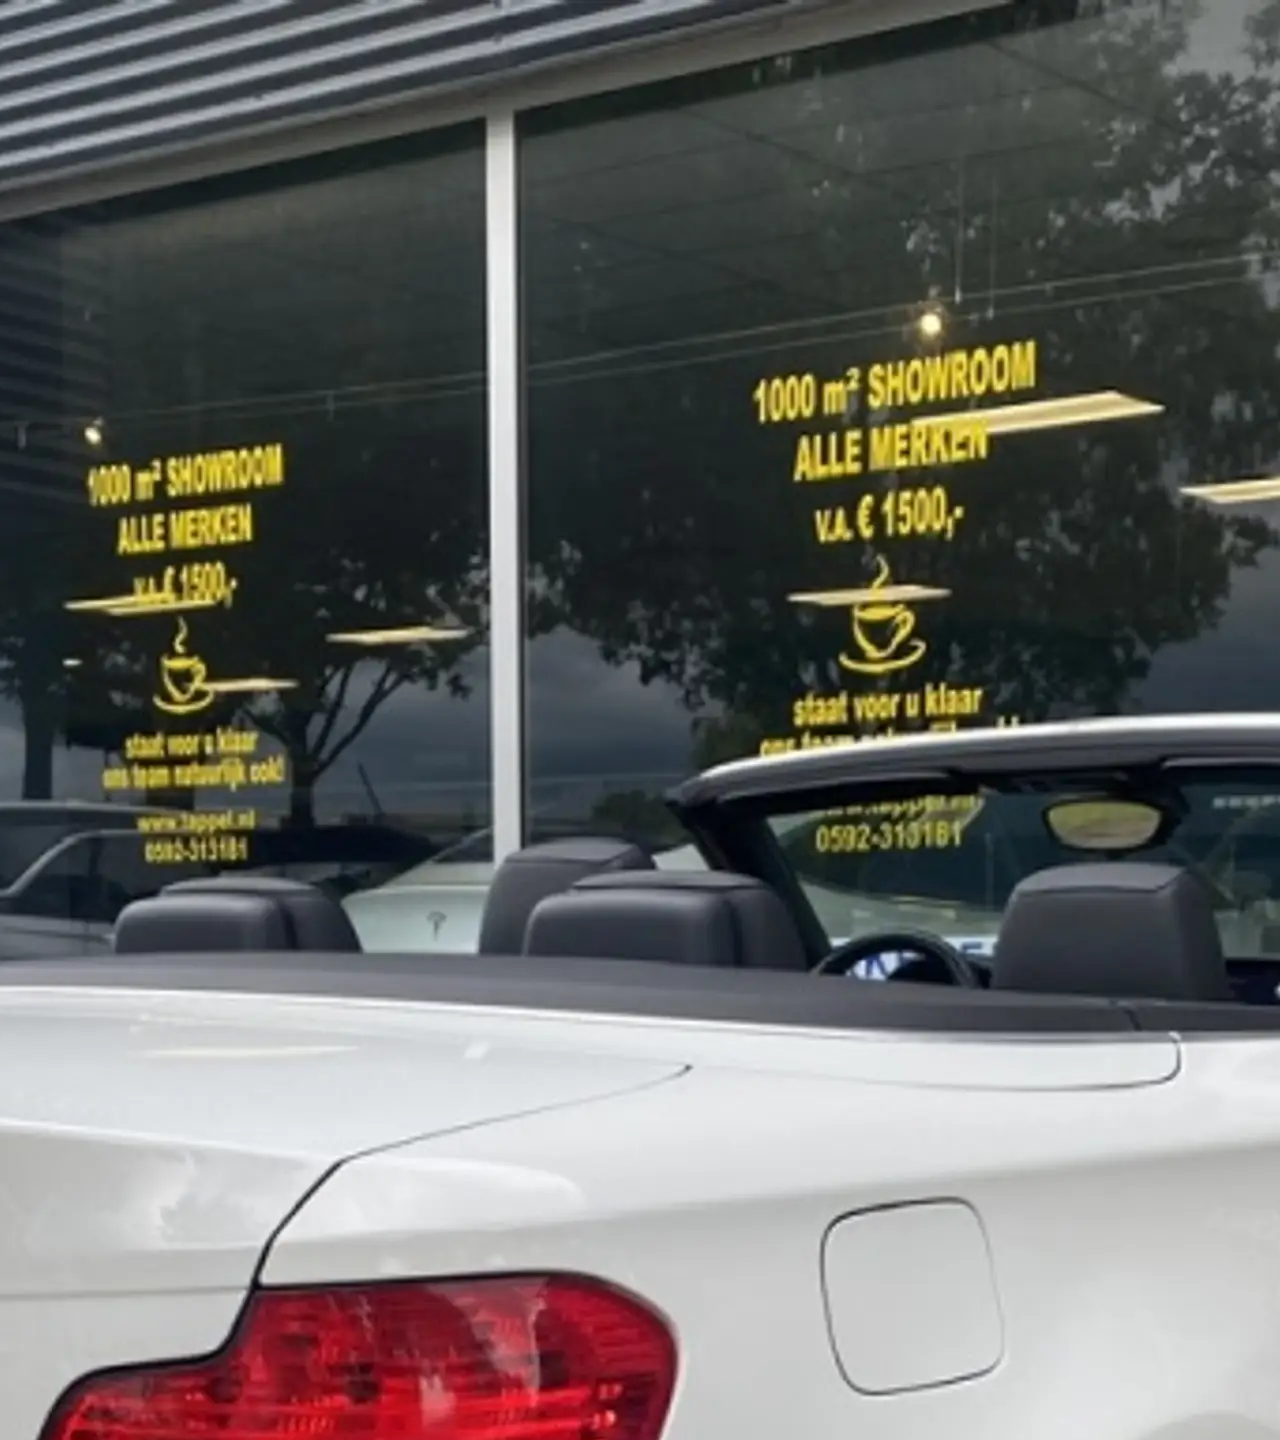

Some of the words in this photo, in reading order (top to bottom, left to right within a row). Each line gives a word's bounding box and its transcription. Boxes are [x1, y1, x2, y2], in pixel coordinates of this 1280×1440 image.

[753, 374, 816, 422] 1000
[867, 340, 1037, 410] SHOWROOM
[88, 463, 131, 506] 1000
[166, 442, 284, 498] SHOWROOM
[793, 429, 863, 481] ALLE
[869, 417, 990, 471] MERKEN
[117, 513, 166, 556] ALLE
[169, 502, 254, 549] MERKEN
[792, 692, 849, 727] staat
[853, 691, 900, 720] voor
[924, 683, 984, 716] klaar
